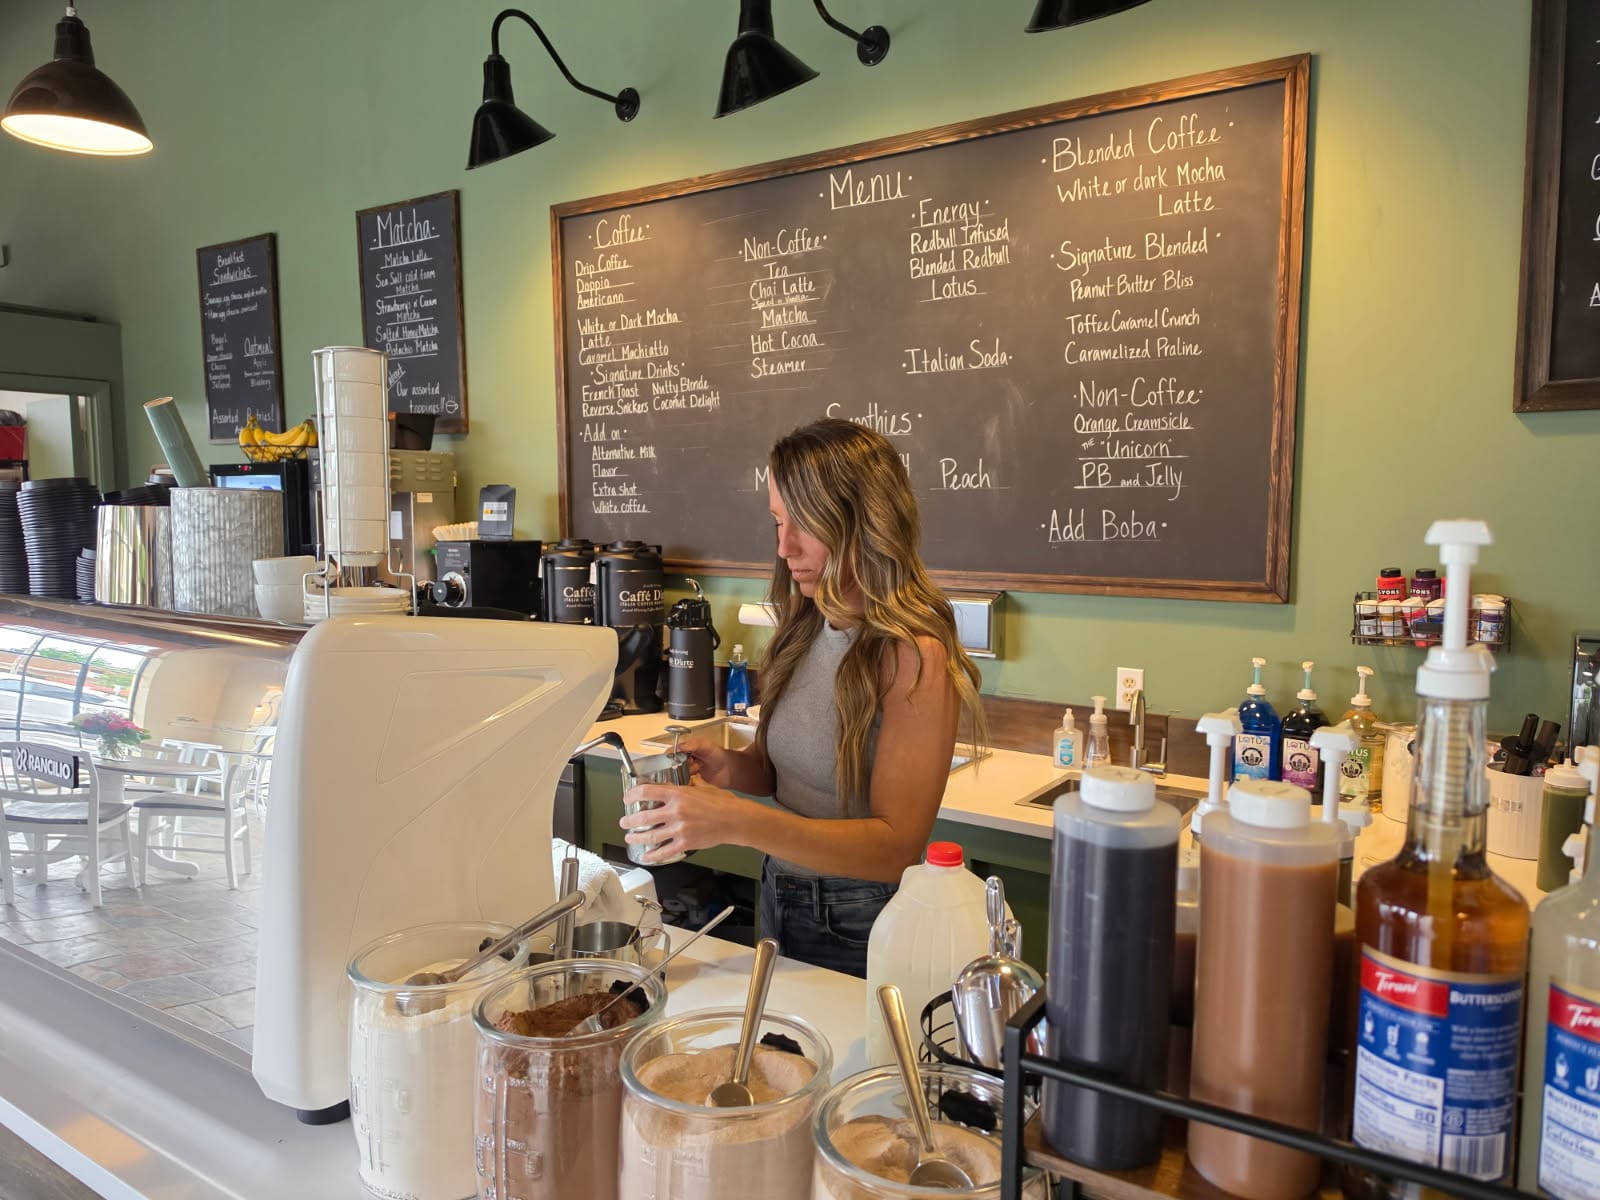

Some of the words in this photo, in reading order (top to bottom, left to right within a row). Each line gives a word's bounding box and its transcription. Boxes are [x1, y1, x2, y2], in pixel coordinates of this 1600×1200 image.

[1053, 129, 1135, 173] Blended
[1148, 113, 1221, 154] Coffee
[830, 169, 903, 209] Menu
[1057, 174, 1112, 203] White
[1115, 178, 1127, 194] or
[1134, 164, 1168, 191] dark
[1177, 157, 1226, 186] Mocha
[920, 199, 980, 229] Energy
[1159, 190, 1215, 216] Latte
[377, 208, 432, 248] Matcha
[596, 214, 646, 249] Coffee
[911, 228, 957, 254] Redbull
[961, 217, 1009, 245] Infused
[744, 228, 820, 261] Non-Coffee
[1057, 236, 1136, 276] Signature
[1145, 227, 1208, 260] Blended
[575, 260, 595, 278] Drip
[598, 254, 630, 271] Coffee
[764, 262, 789, 279] Tea
[910, 249, 956, 279] Blended
[963, 245, 1010, 270] Redbull
[576, 278, 610, 296] Doppio
[750, 281, 777, 301] Chai
[783, 276, 816, 296] Latte
[932, 276, 977, 300] Lotus
[1070, 276, 1114, 302] Peanut
[1117, 274, 1156, 296] Butter
[1163, 269, 1194, 290] Bliss
[577, 292, 624, 310] Americano
[577, 315, 606, 335] White
[608, 321, 617, 331] or
[620, 313, 642, 330] Dark
[646, 307, 678, 326] Mocha
[762, 306, 809, 328] Matcha
[1066, 314, 1110, 335] Toffee
[1111, 309, 1158, 332] Caramel
[1161, 307, 1200, 328] Crunch
[581, 334, 612, 351] Latte
[751, 333, 774, 354] Hot
[781, 331, 818, 350] Cocoa
[1065, 340, 1151, 365] Caramelized
[1157, 337, 1203, 358] Praline
[578, 348, 617, 366] Caramel
[751, 357, 806, 378] Steamer
[905, 348, 964, 374] Italian
[968, 337, 1009, 369] Soda
[594, 363, 642, 385] Signature
[647, 360, 680, 379] Drinks
[412, 382, 440, 395] assorted
[582, 385, 613, 402] French
[613, 382, 640, 399] Toast
[652, 380, 679, 399] Nutty
[680, 375, 710, 393] Blonde
[1080, 377, 1200, 408] Non-Coffee
[582, 402, 616, 418] Reverse
[615, 398, 649, 415] Snickers
[653, 396, 686, 411] Coconut
[690, 391, 720, 412] Delight
[826, 402, 912, 434] Sothies
[1074, 413, 1120, 439] Orange
[1125, 412, 1190, 431] Creamsicle
[584, 422, 606, 442] Add
[611, 429, 621, 441] on
[592, 444, 635, 460] Alternative
[639, 445, 656, 459] Milk
[592, 463, 618, 477] Flavor
[940, 458, 992, 490] Peach
[1082, 463, 1112, 487] PB
[1121, 473, 1140, 487] and
[1145, 462, 1182, 501] Jelly
[592, 482, 616, 497] Extra
[619, 482, 638, 496] shot
[592, 499, 618, 514] White
[620, 499, 648, 513] coffee
[1049, 508, 1085, 541] Add
[1103, 509, 1157, 540] Boba
[619, 590, 652, 602] Caffé
[1238, 735, 1269, 746] LOTUS
[1286, 739, 1312, 750] LOTU
[28, 754, 71, 780] RANCILIO
[1375, 971, 1418, 994] Torani
